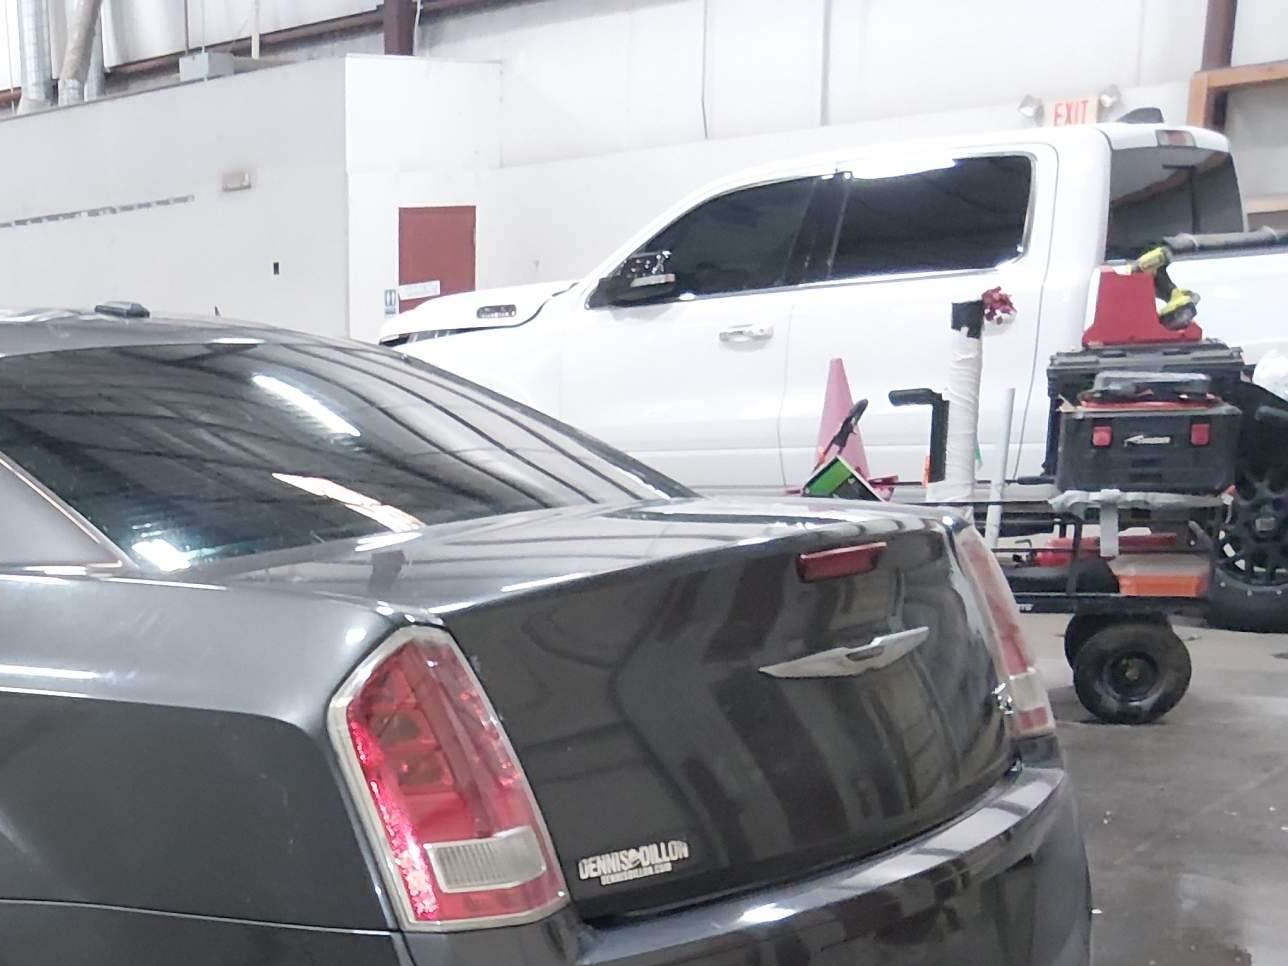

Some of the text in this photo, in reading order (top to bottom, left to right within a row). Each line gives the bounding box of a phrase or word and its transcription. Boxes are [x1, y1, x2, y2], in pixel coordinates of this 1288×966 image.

[1053, 100, 1089, 127] EXIT
[578, 849, 631, 880] DENNIS
[638, 840, 689, 867] DILLON
